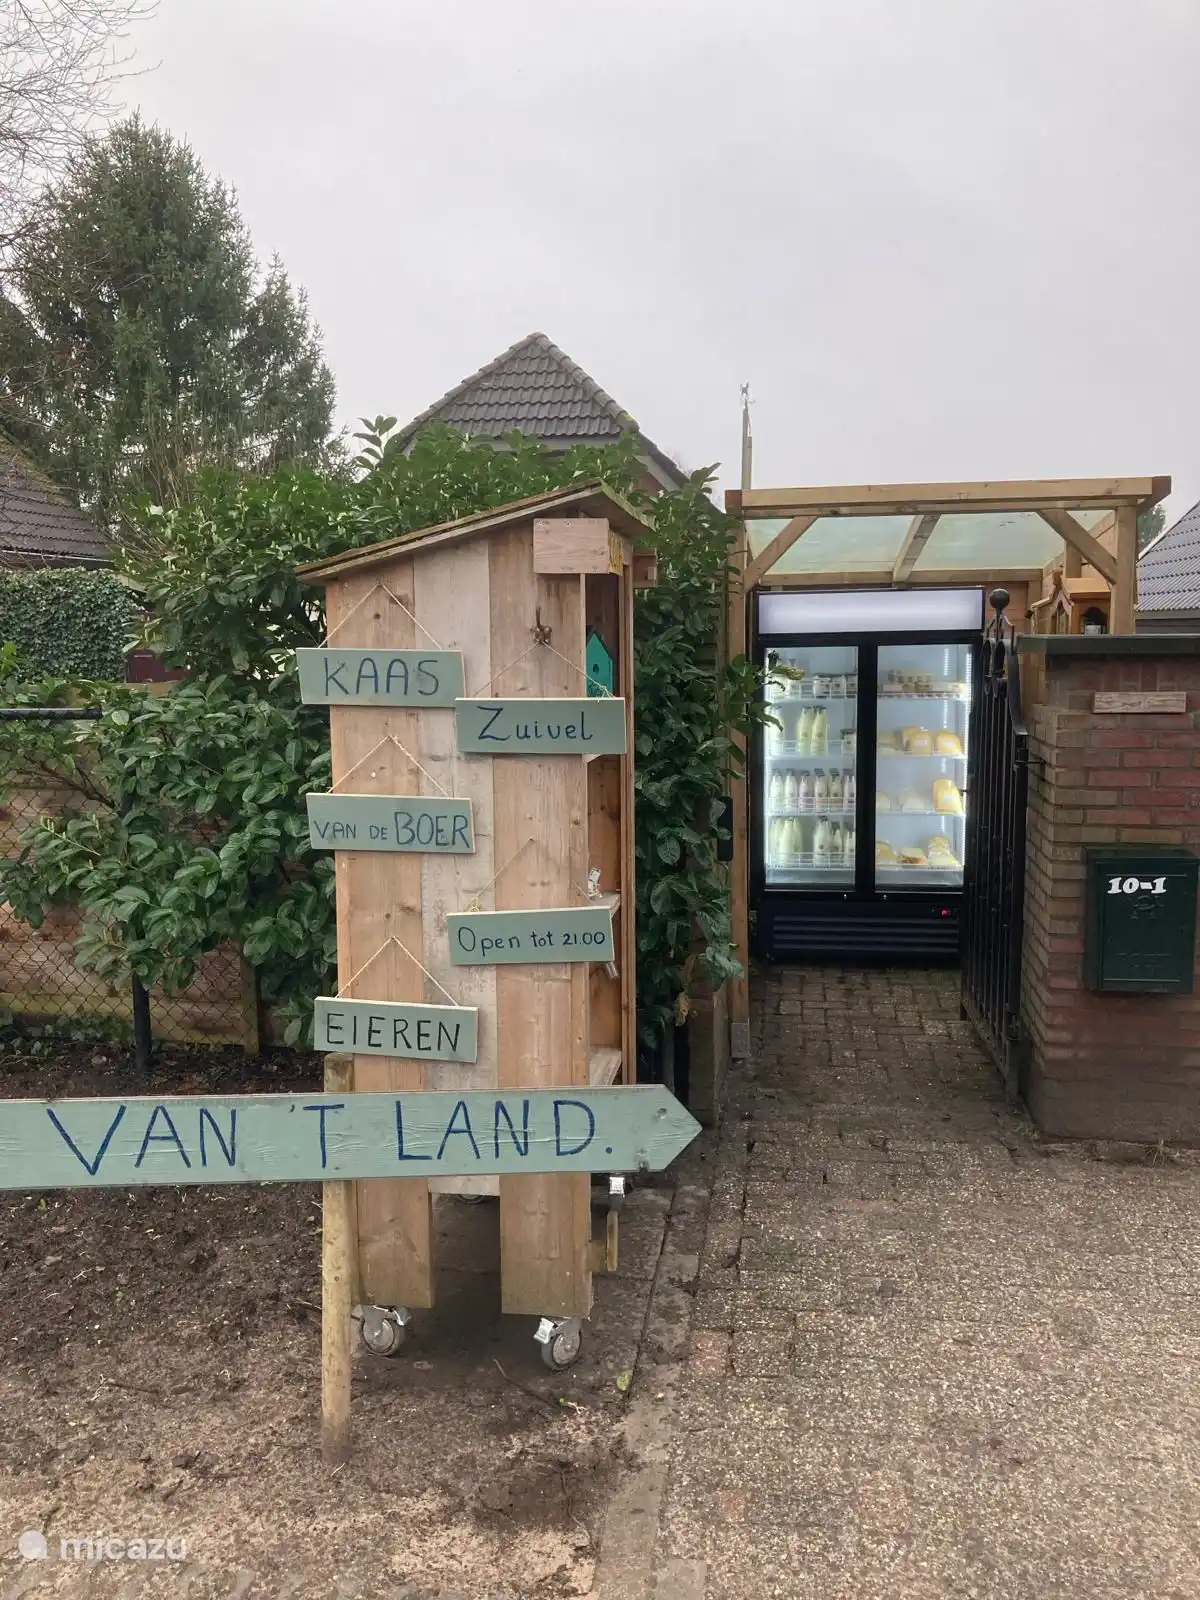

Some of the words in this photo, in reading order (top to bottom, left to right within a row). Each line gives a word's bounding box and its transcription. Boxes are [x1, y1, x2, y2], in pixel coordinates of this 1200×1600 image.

[324, 657, 440, 697] KAAS
[476, 705, 593, 741] Zuivel
[313, 820, 357, 840] VAN
[369, 825, 389, 841] DE
[394, 811, 470, 848] BOER
[1107, 876, 1167, 894] 10-1
[458, 926, 520, 957] Open
[530, 931, 554, 947] tot
[326, 1013, 460, 1052] EIEREN
[46, 1104, 237, 1177] VAN
[289, 1103, 345, 1169] 'T
[396, 1099, 614, 1163] LAND.
